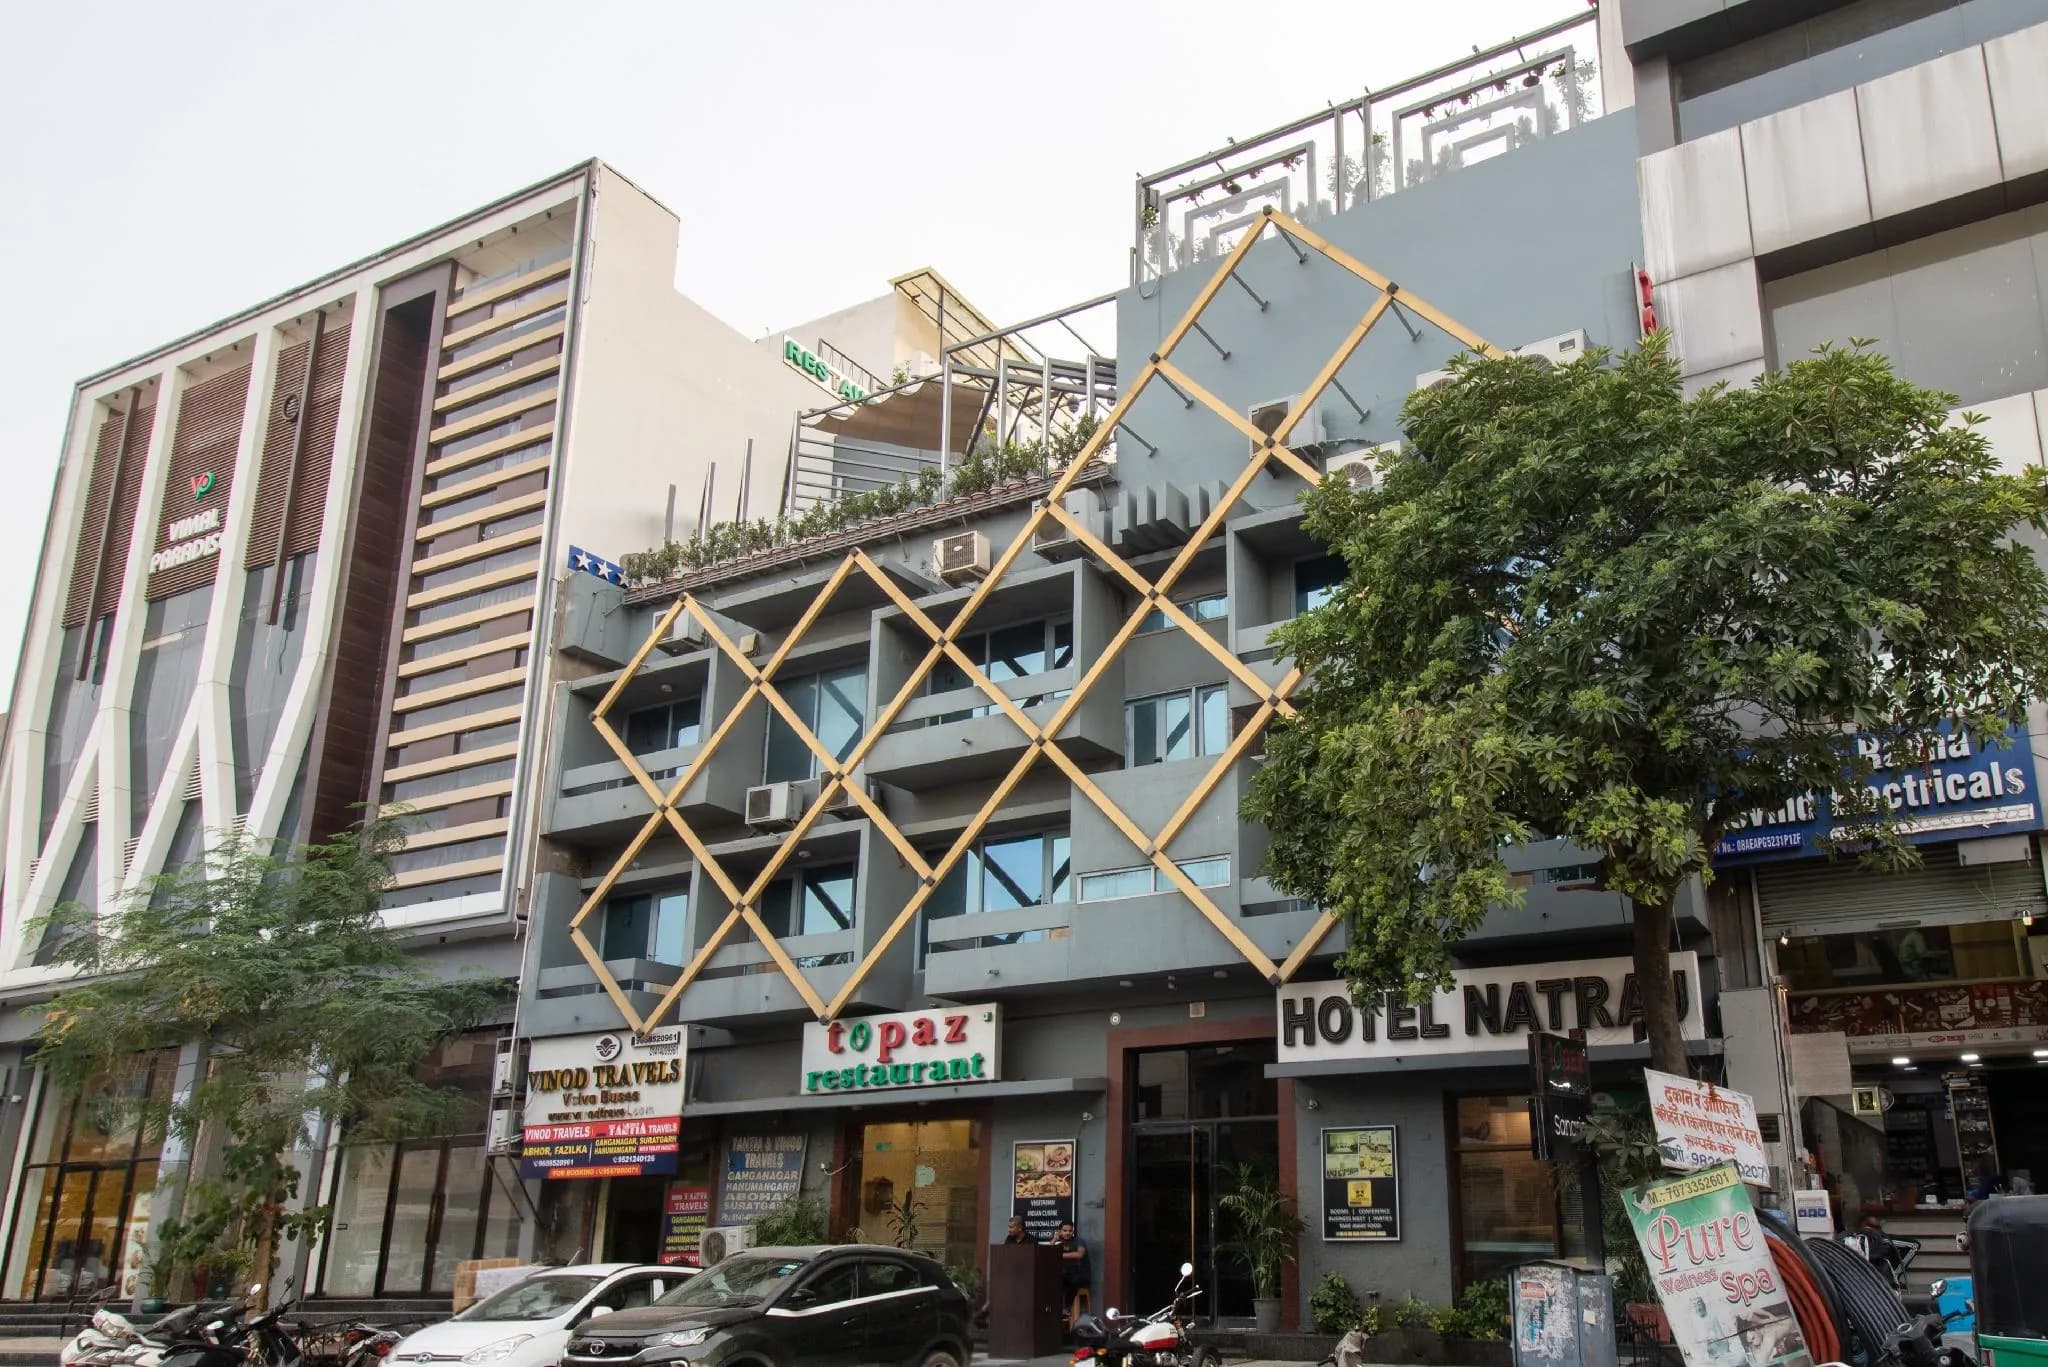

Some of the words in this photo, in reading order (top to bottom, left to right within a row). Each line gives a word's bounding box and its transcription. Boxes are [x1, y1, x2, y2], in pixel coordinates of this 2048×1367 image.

[170, 508, 220, 541] VIMAL
[149, 532, 222, 574] PARADIS
[1283, 990, 1450, 1047] HOTEL
[827, 1015, 969, 1063] topaz
[528, 1067, 589, 1092] VINOD
[593, 1058, 682, 1088] TRAVELS
[806, 1052, 985, 1091] restaurant
[600, 1090, 640, 1103] Buses
[525, 1129, 551, 1140] VINOD
[553, 1126, 591, 1139] TRAVELS
[648, 1123, 678, 1133] TRAVELS
[554, 1145, 588, 1156] FAZILKA
[744, 1152, 784, 1168] TRAVELS
[727, 1171, 798, 1181] GANGANAGAR
[726, 1182, 795, 1192] HANUMANGARH
[674, 1202, 709, 1211] TRAVELS
[1648, 1208, 1754, 1275] Pure
[1659, 1268, 1719, 1295] Wellness
